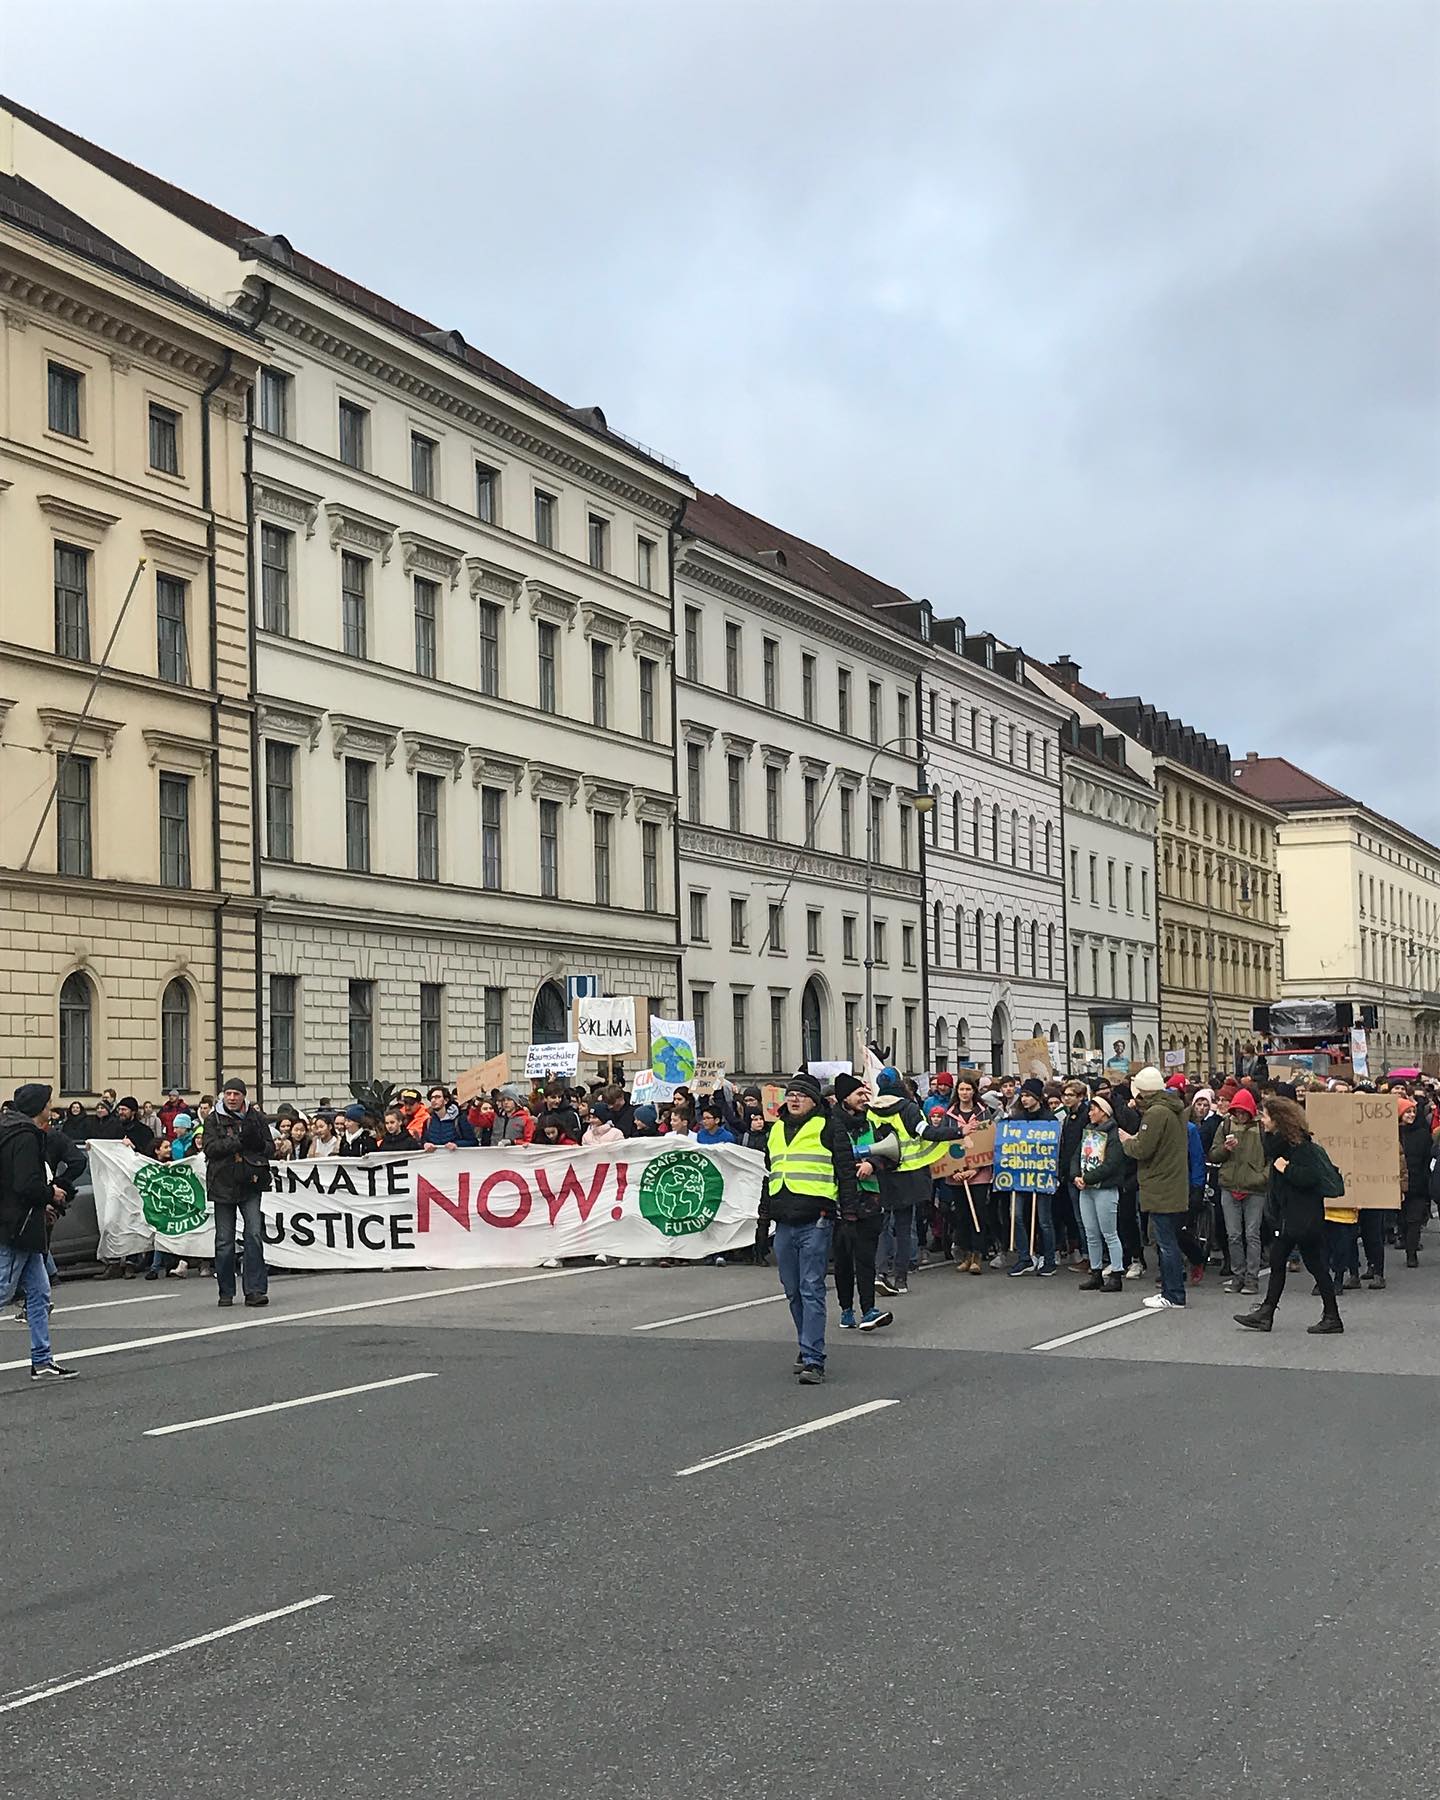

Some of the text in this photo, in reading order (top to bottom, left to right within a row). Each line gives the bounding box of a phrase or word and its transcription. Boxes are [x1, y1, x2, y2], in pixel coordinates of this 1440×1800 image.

[1354, 1102, 1393, 1124] JOBS
[1026, 1128, 1056, 1140] seen
[1001, 1141, 1054, 1155] smarter
[641, 1153, 709, 1192] FRIDAYS FOR
[1000, 1156, 1056, 1171] cabinets
[271, 1160, 410, 1197] IMATE
[995, 1171, 1054, 1190] @ IKEA
[417, 1163, 629, 1233] NOW!
[166, 1210, 208, 1233] FUTUR
[262, 1212, 415, 1250] USTICE
[665, 1206, 714, 1233] FUTURE
